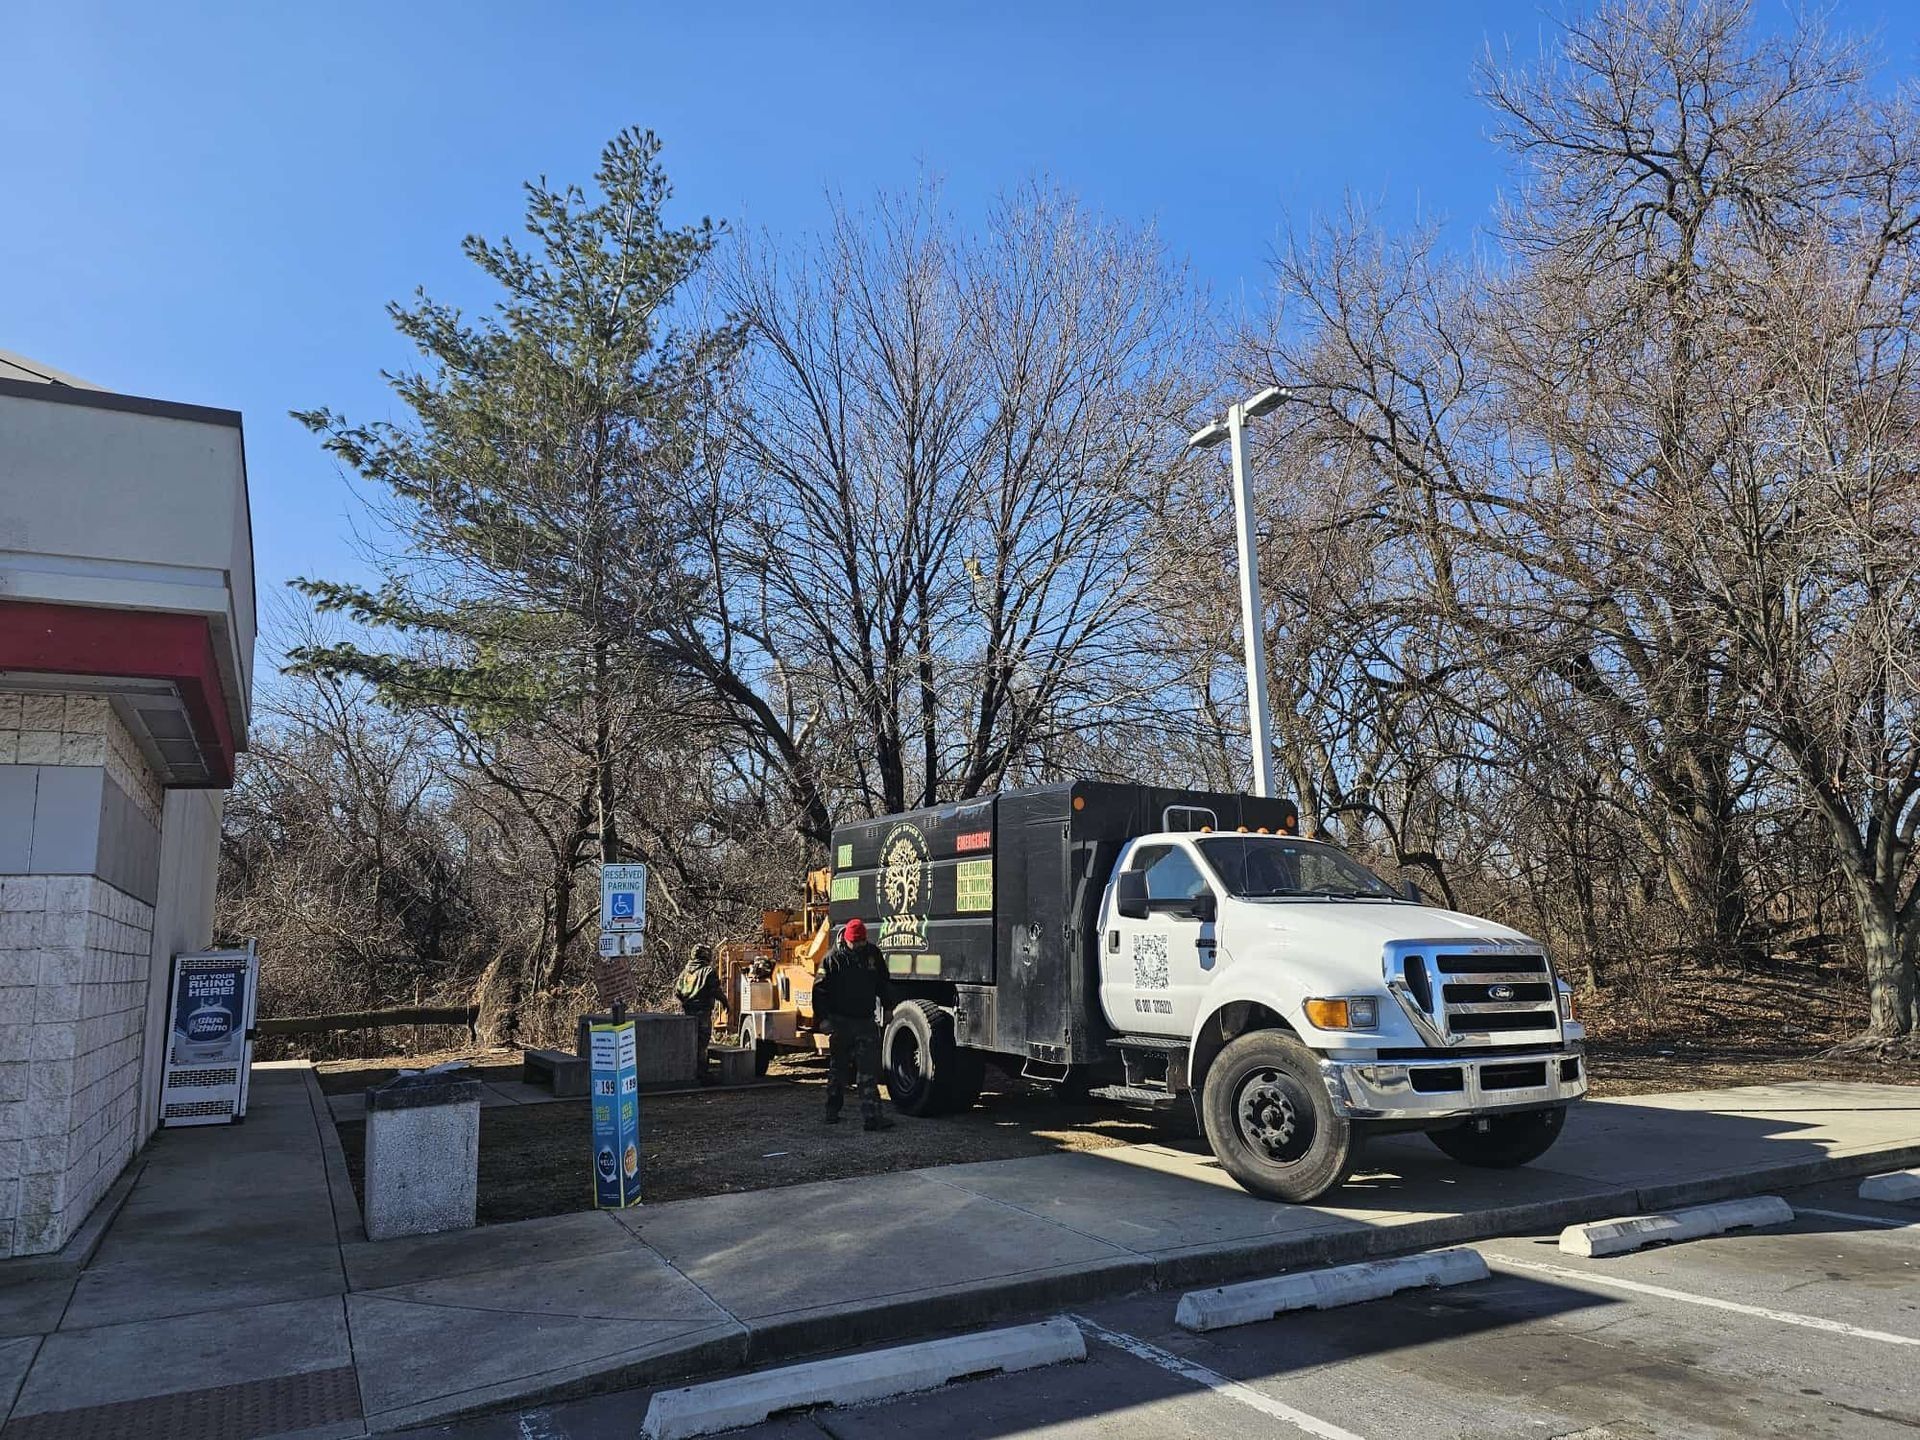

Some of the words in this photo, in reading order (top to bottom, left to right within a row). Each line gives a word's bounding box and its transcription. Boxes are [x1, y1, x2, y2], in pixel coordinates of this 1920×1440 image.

[956, 832, 991, 851] EMERGENCY
[605, 870, 642, 880] RESERVED
[608, 881, 640, 890] PARKING
[879, 914, 919, 939] ALPHA
[881, 935, 893, 948] TREE
[894, 934, 914, 947] EXPERTS
[188, 979, 235, 988] RHINO
[188, 986, 235, 997] HERE!
